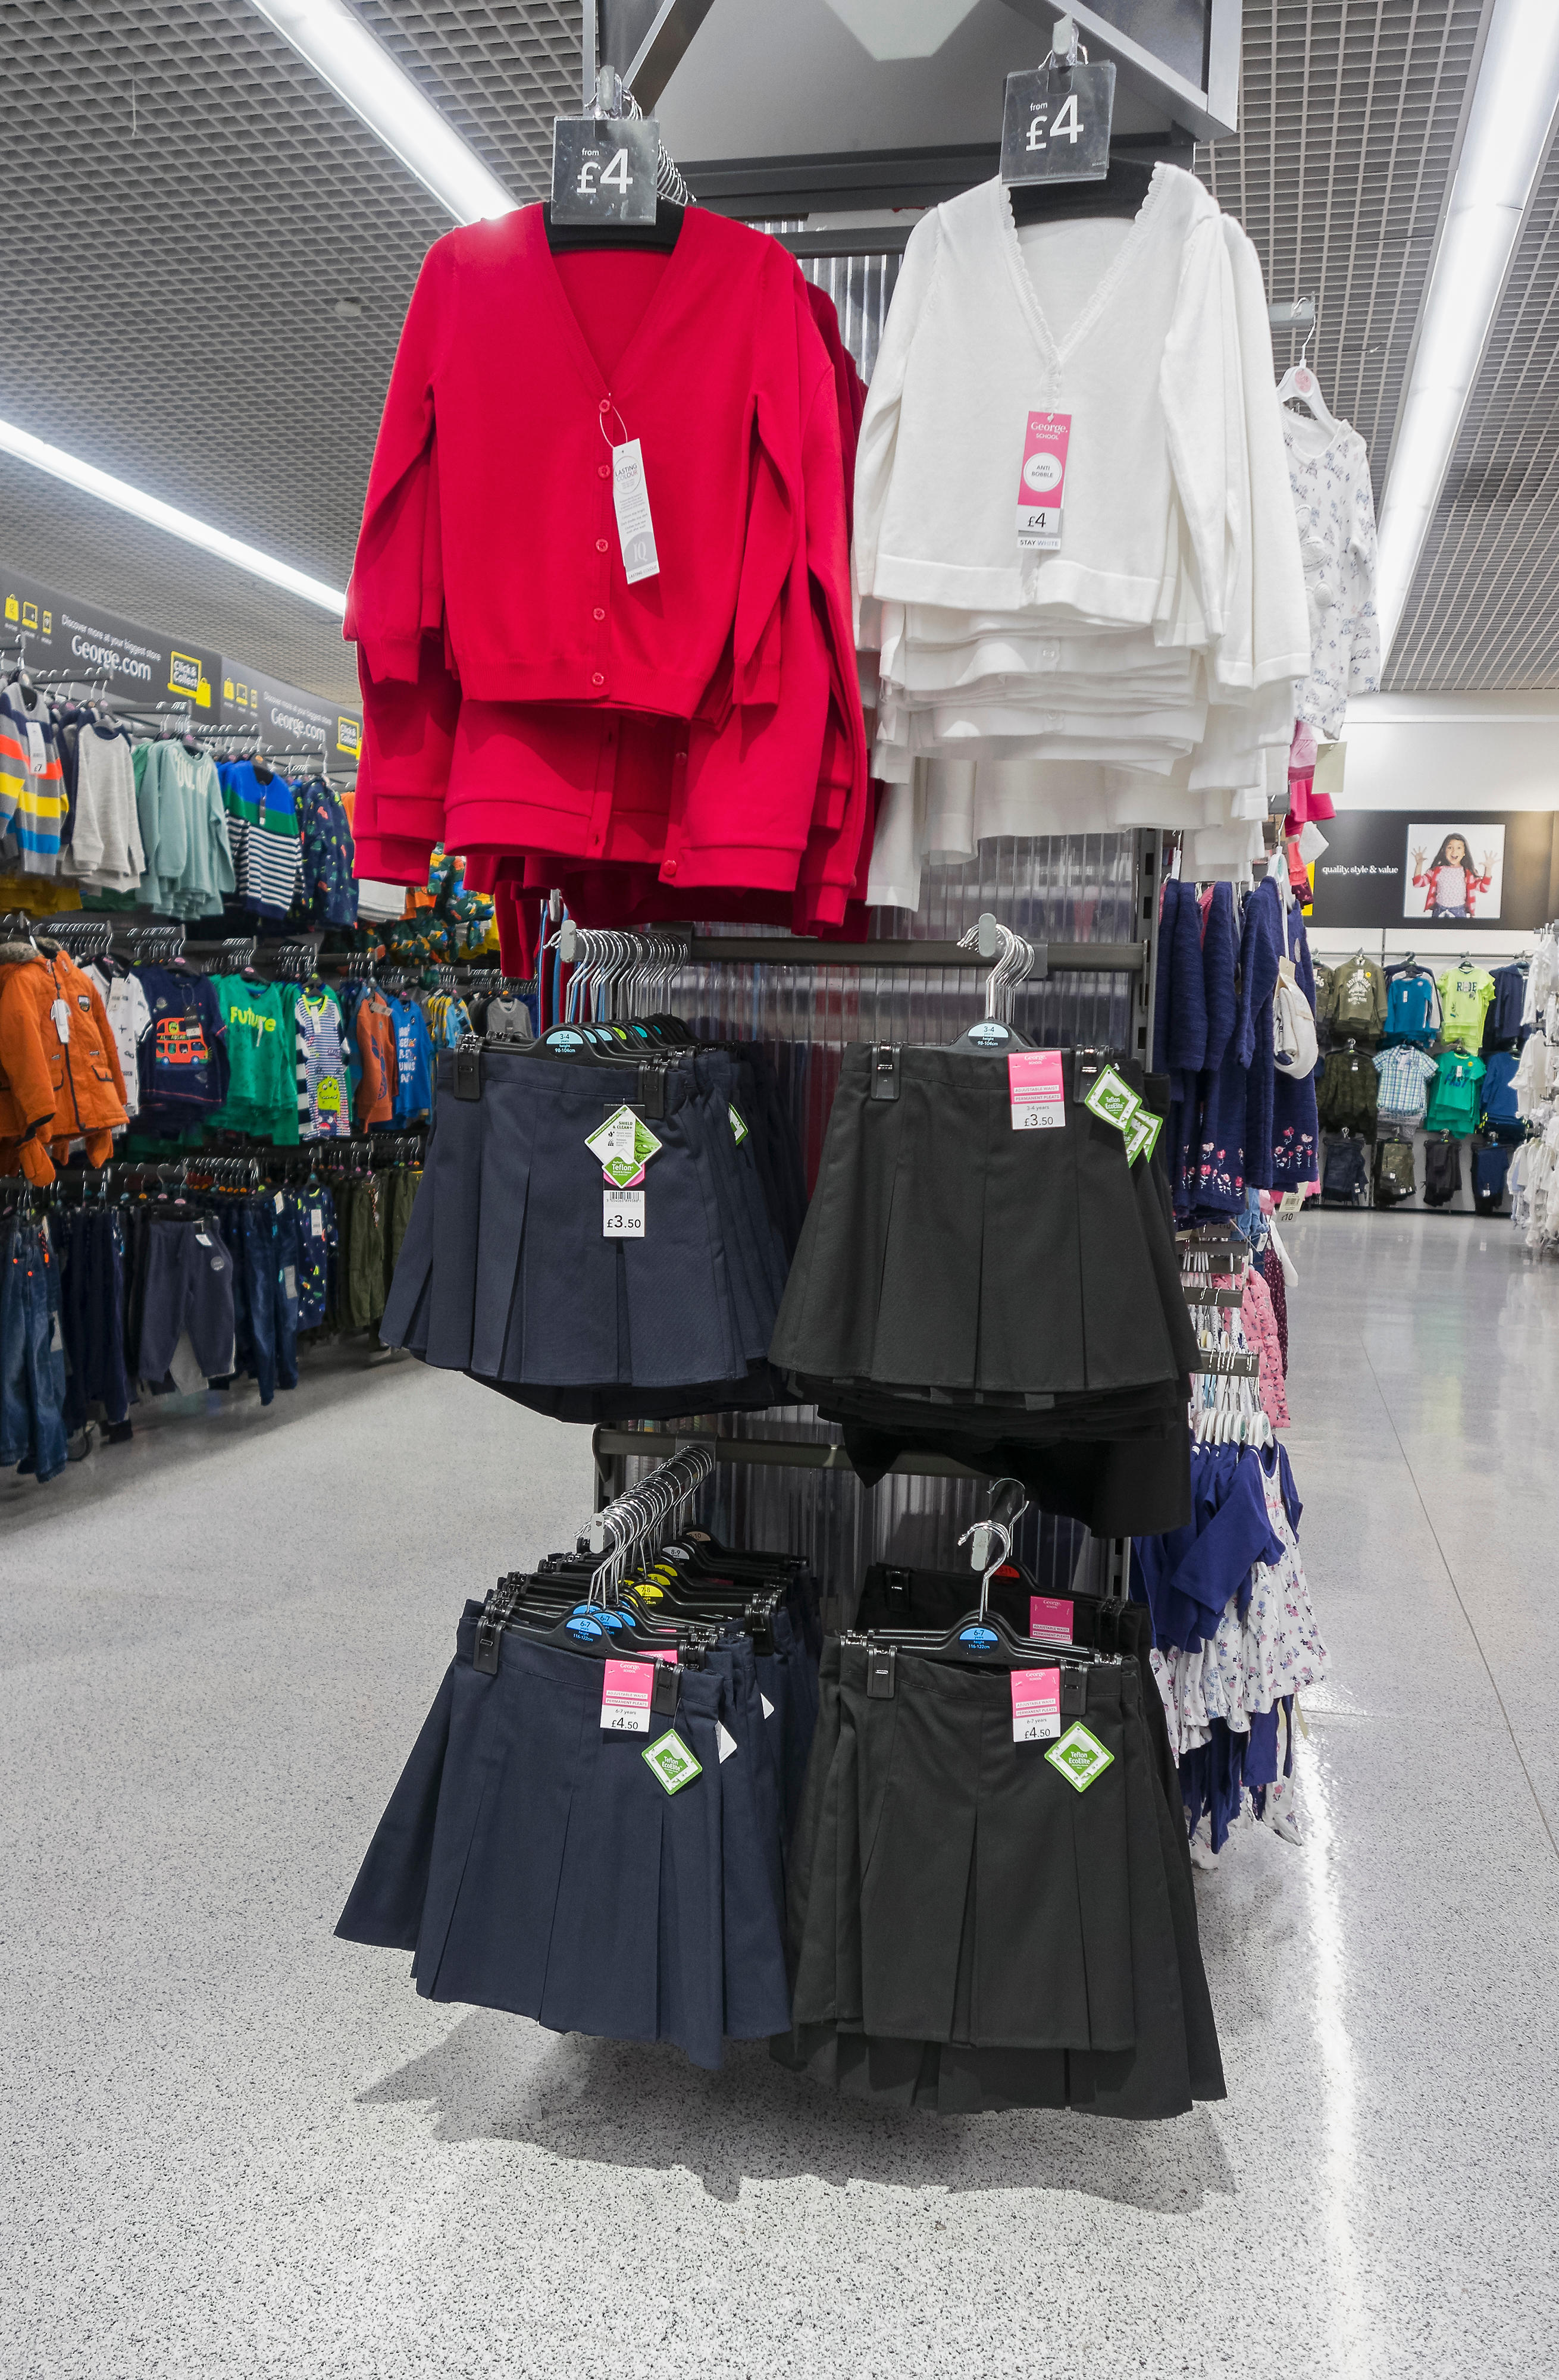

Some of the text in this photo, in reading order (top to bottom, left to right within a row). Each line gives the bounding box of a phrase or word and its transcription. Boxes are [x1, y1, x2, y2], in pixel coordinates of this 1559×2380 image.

[1030, 102, 1047, 111] from
[1026, 95, 1084, 151] £4
[577, 148, 633, 194] £4
[615, 463, 637, 477] LASTING
[616, 469, 638, 481] COLOUR
[1028, 512, 1046, 528] £4
[71, 625, 151, 681] George.com
[271, 708, 325, 742] George.com
[34, 763, 42, 772] £7
[1322, 865, 1350, 875] quality,
[1350, 865, 1369, 875] style
[1024, 1114, 1053, 1126] £3.50
[607, 1215, 641, 1228] £3.50
[611, 1717, 638, 1730] £4.50
[1025, 1727, 1050, 1739] £4.50
[663, 1756, 678, 1765] Teflon
